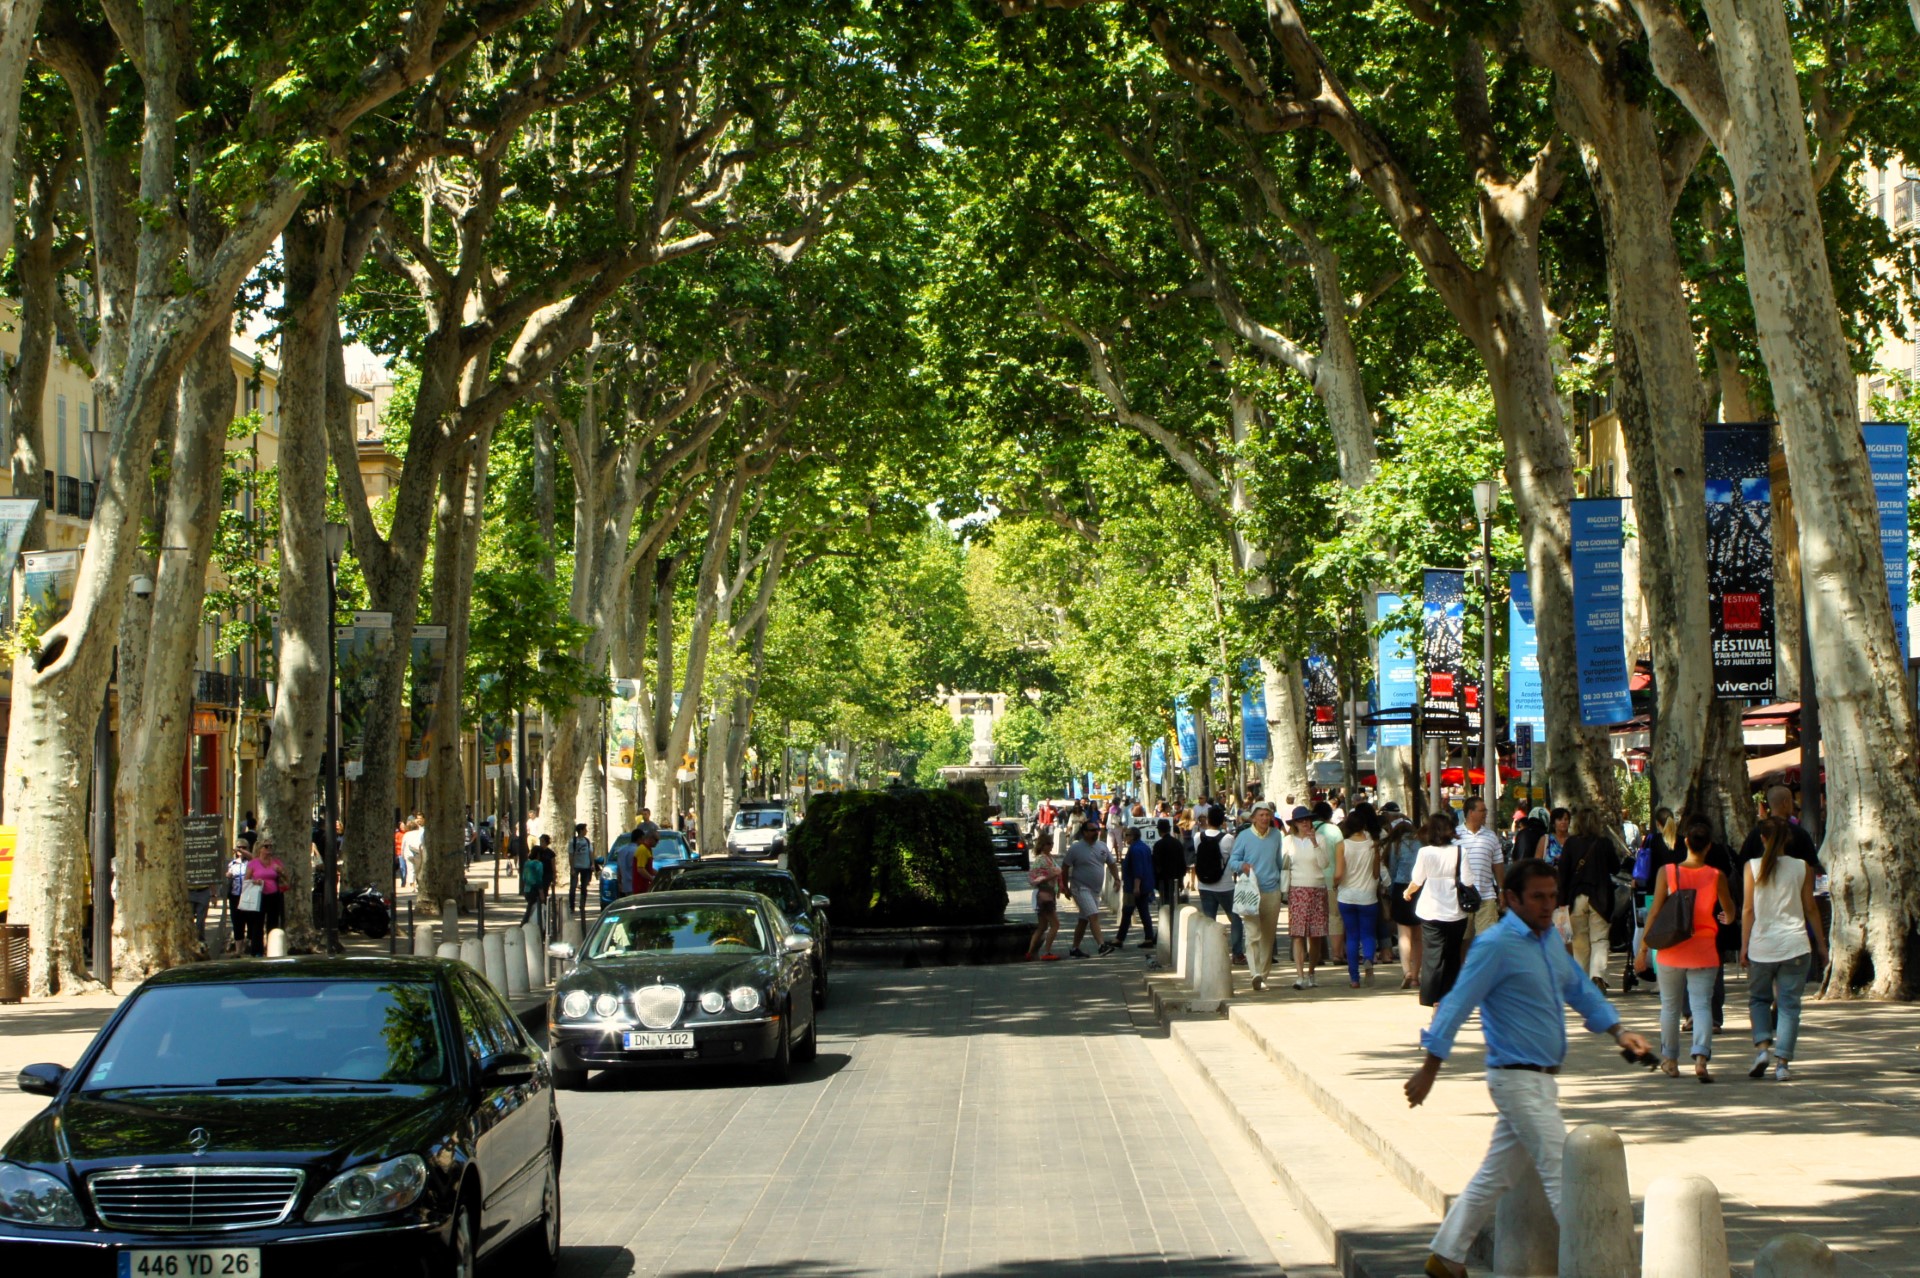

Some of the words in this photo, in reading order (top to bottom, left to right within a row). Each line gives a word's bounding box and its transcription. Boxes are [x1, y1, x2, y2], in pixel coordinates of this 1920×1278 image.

[1872, 473, 1903, 481] IOVANNI
[1877, 501, 1903, 509] LEKTRA
[1881, 529, 1903, 537] ELENA
[1595, 561, 1619, 569] ELEKTRA
[1724, 595, 1759, 603] FESTIVAL
[1714, 639, 1772, 652] FESTIVAL
[1714, 651, 1772, 659] D'AIX-EN-PROVENCE
[1717, 677, 1773, 692] vivendi
[1424, 701, 1459, 710] FESTIVAL
[635, 1034, 650, 1046] DN
[657, 1034, 665, 1046] Y
[667, 1033, 689, 1045] 102
[137, 1255, 178, 1276] 446
[186, 1254, 213, 1275] YD
[221, 1253, 249, 1274] 26
